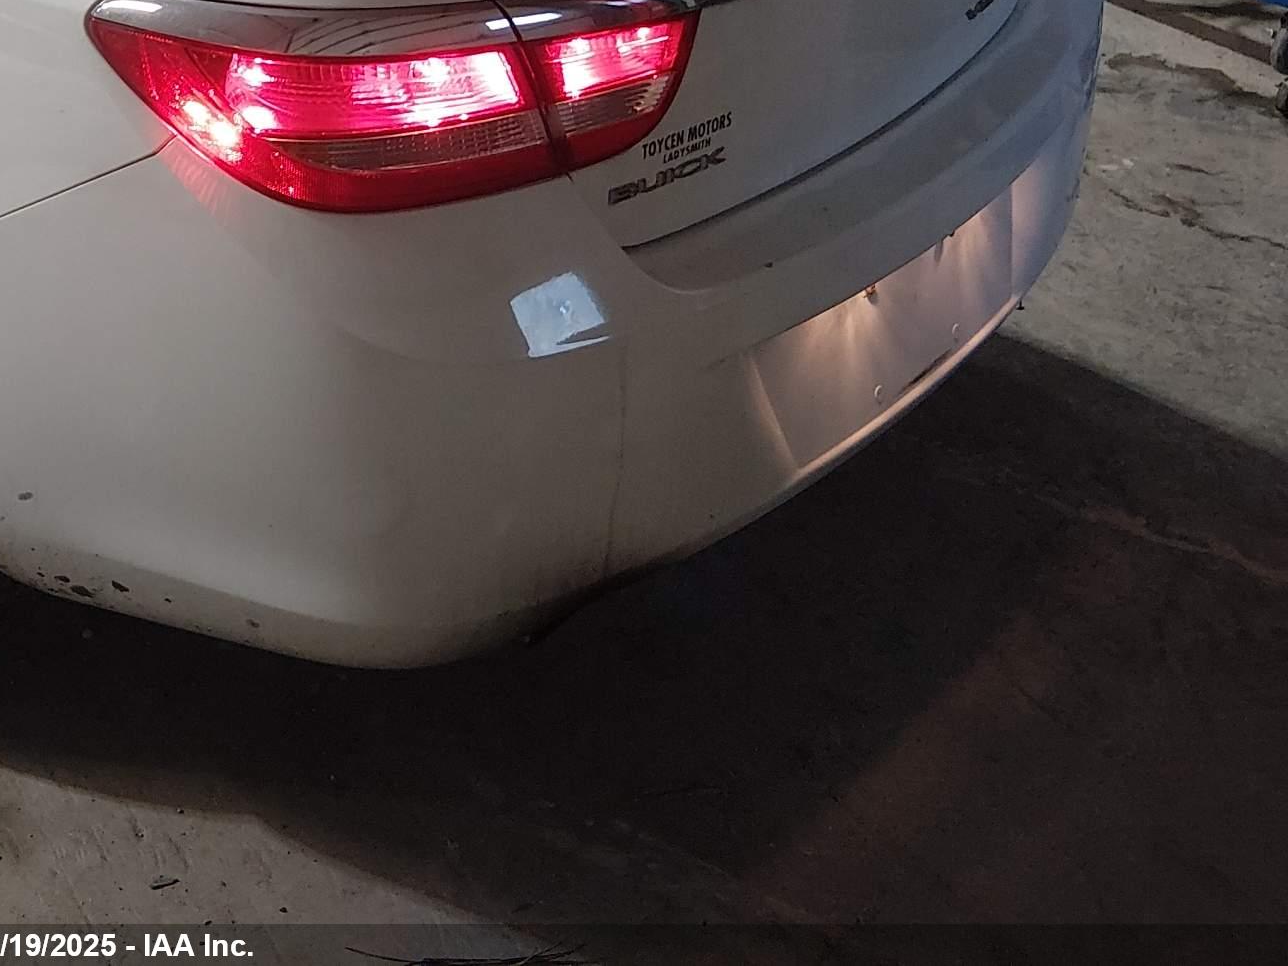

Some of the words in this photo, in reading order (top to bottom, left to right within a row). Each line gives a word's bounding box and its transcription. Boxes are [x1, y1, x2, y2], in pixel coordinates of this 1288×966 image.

[642, 130, 685, 160] TOYCEN
[687, 111, 732, 142] MOTORS
[663, 137, 712, 164] LADYSMITH
[608, 146, 727, 206] BUICK
